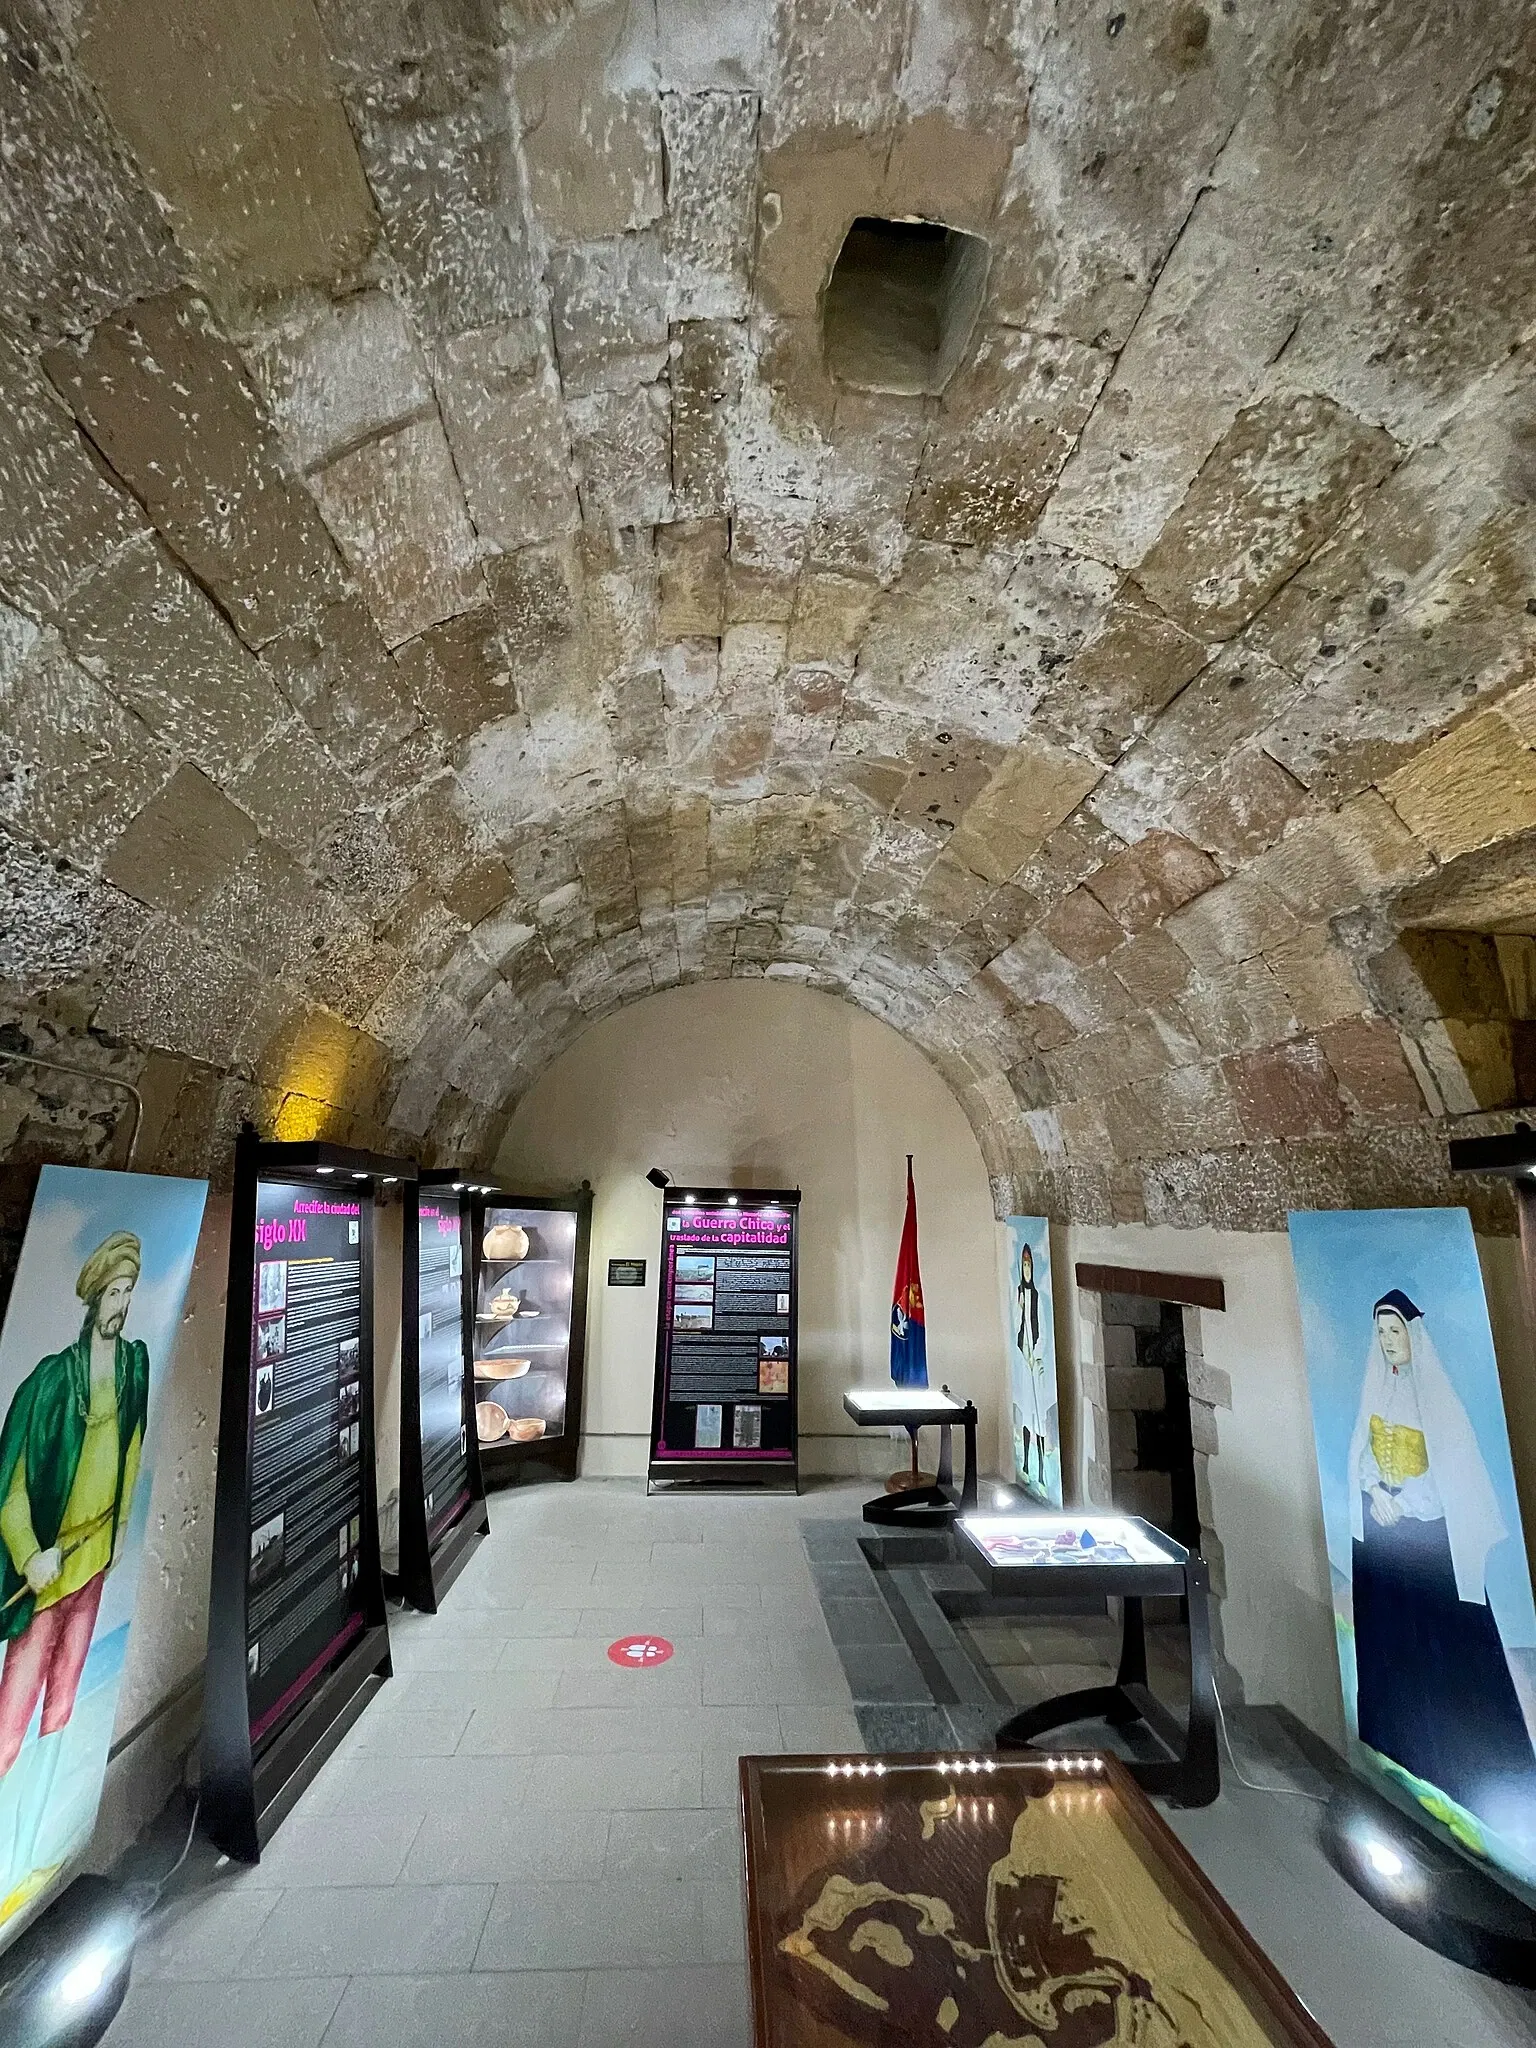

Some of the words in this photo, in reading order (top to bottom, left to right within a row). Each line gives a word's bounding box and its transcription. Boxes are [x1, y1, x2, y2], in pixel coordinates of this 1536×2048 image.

[288, 1219, 306, 1242] XX
[682, 1220, 690, 1228] la
[693, 1216, 736, 1229] Guerra
[739, 1217, 774, 1231] Chica
[776, 1224, 782, 1232] y
[783, 1223, 791, 1231] el
[670, 1234, 700, 1242] traslado
[701, 1234, 711, 1242] de
[712, 1234, 719, 1242] la
[720, 1232, 787, 1245] capitalidad
